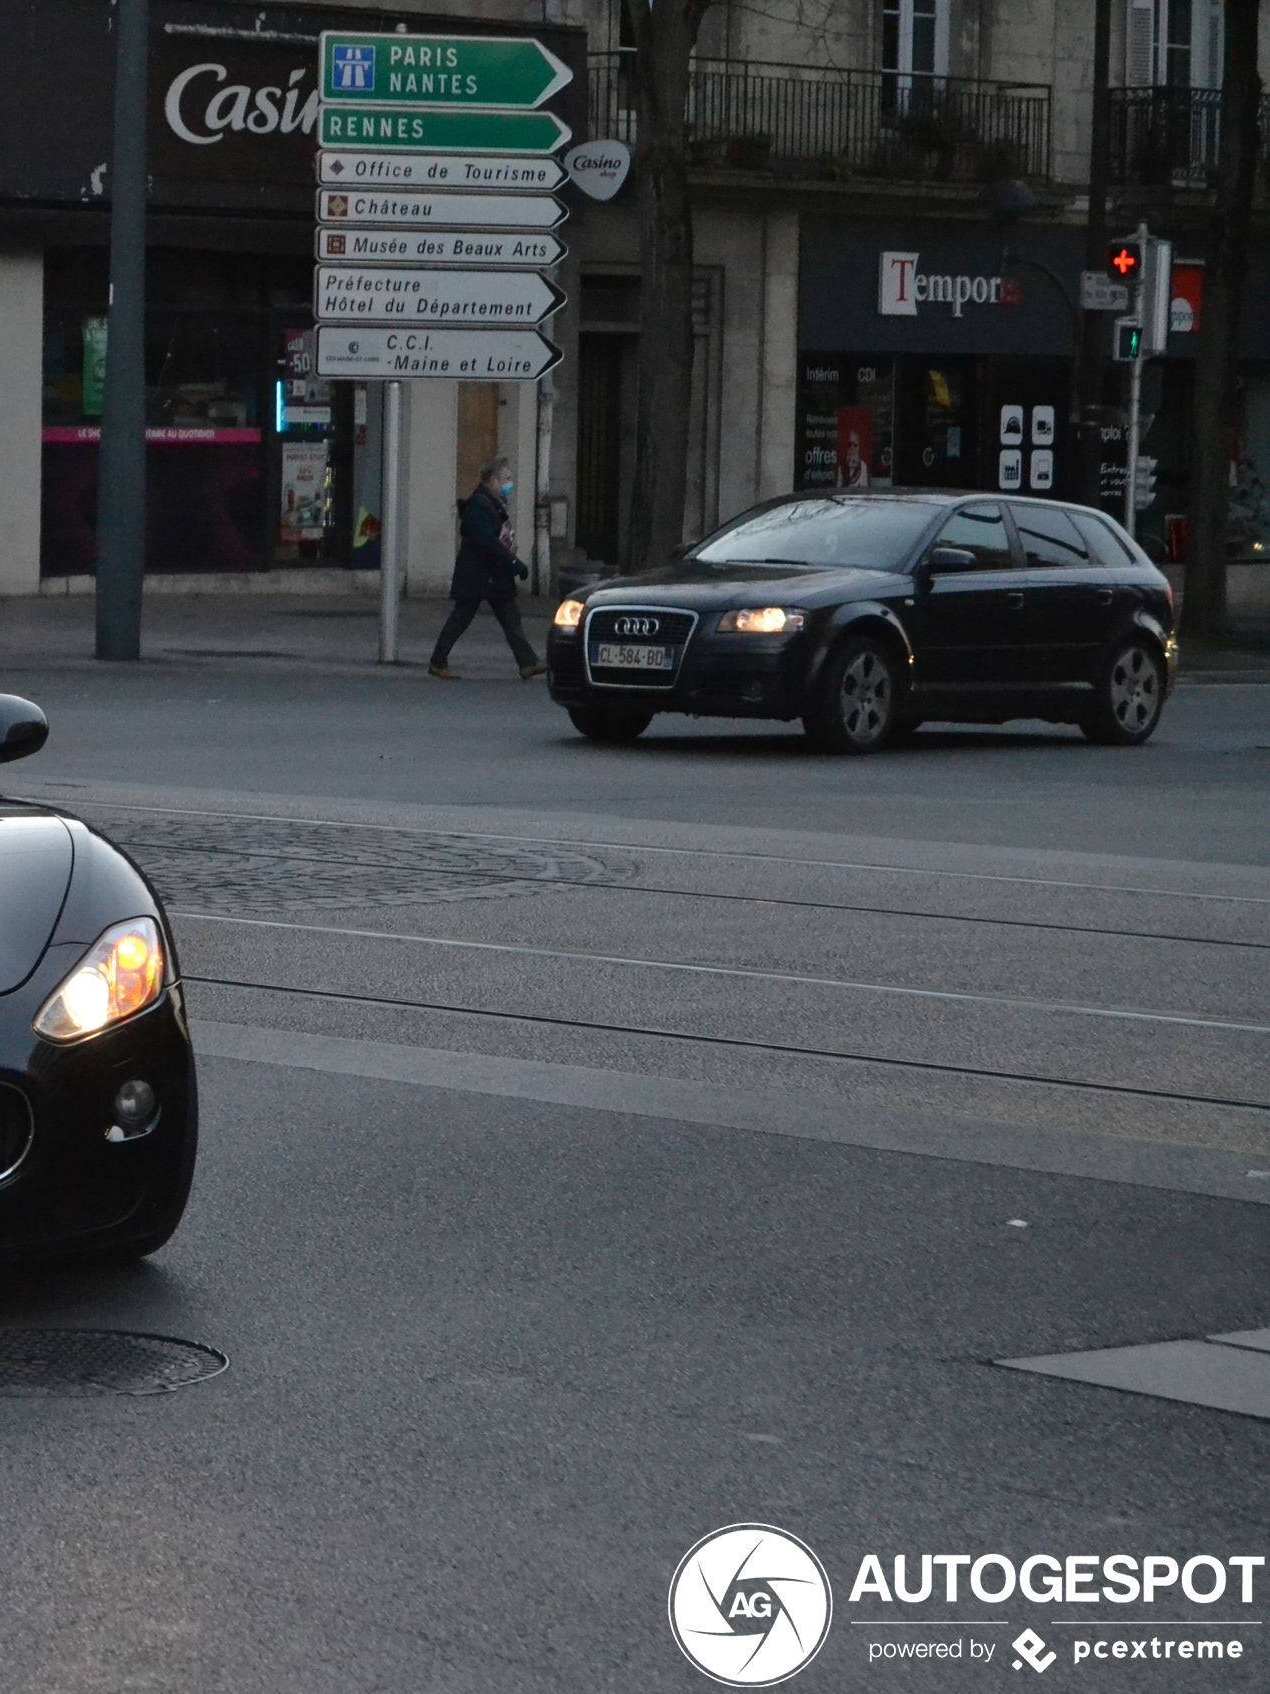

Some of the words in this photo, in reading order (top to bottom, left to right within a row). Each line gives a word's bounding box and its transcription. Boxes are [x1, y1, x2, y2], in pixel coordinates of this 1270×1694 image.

[390, 46, 458, 67] PARIS
[390, 73, 478, 94] NANTES
[330, 115, 424, 139] RENNES
[355, 160, 412, 178] Office
[428, 162, 448, 179] de
[465, 164, 546, 182] Tourisme
[573, 154, 621, 172] Casino
[355, 199, 432, 216] Château
[353, 237, 407, 254] Musée
[417, 238, 445, 255] des
[453, 240, 503, 256] Beaux
[513, 241, 547, 257] Arts
[326, 275, 421, 293] Préfecture
[326, 296, 373, 313] Hôtel
[385, 297, 405, 313] du
[417, 298, 532, 318] Département
[387, 335, 434, 351] C.C.I.
[460, 358, 477, 372] et
[487, 357, 532, 373] Loire
[599, 646, 663, 666] CL-584-BD
